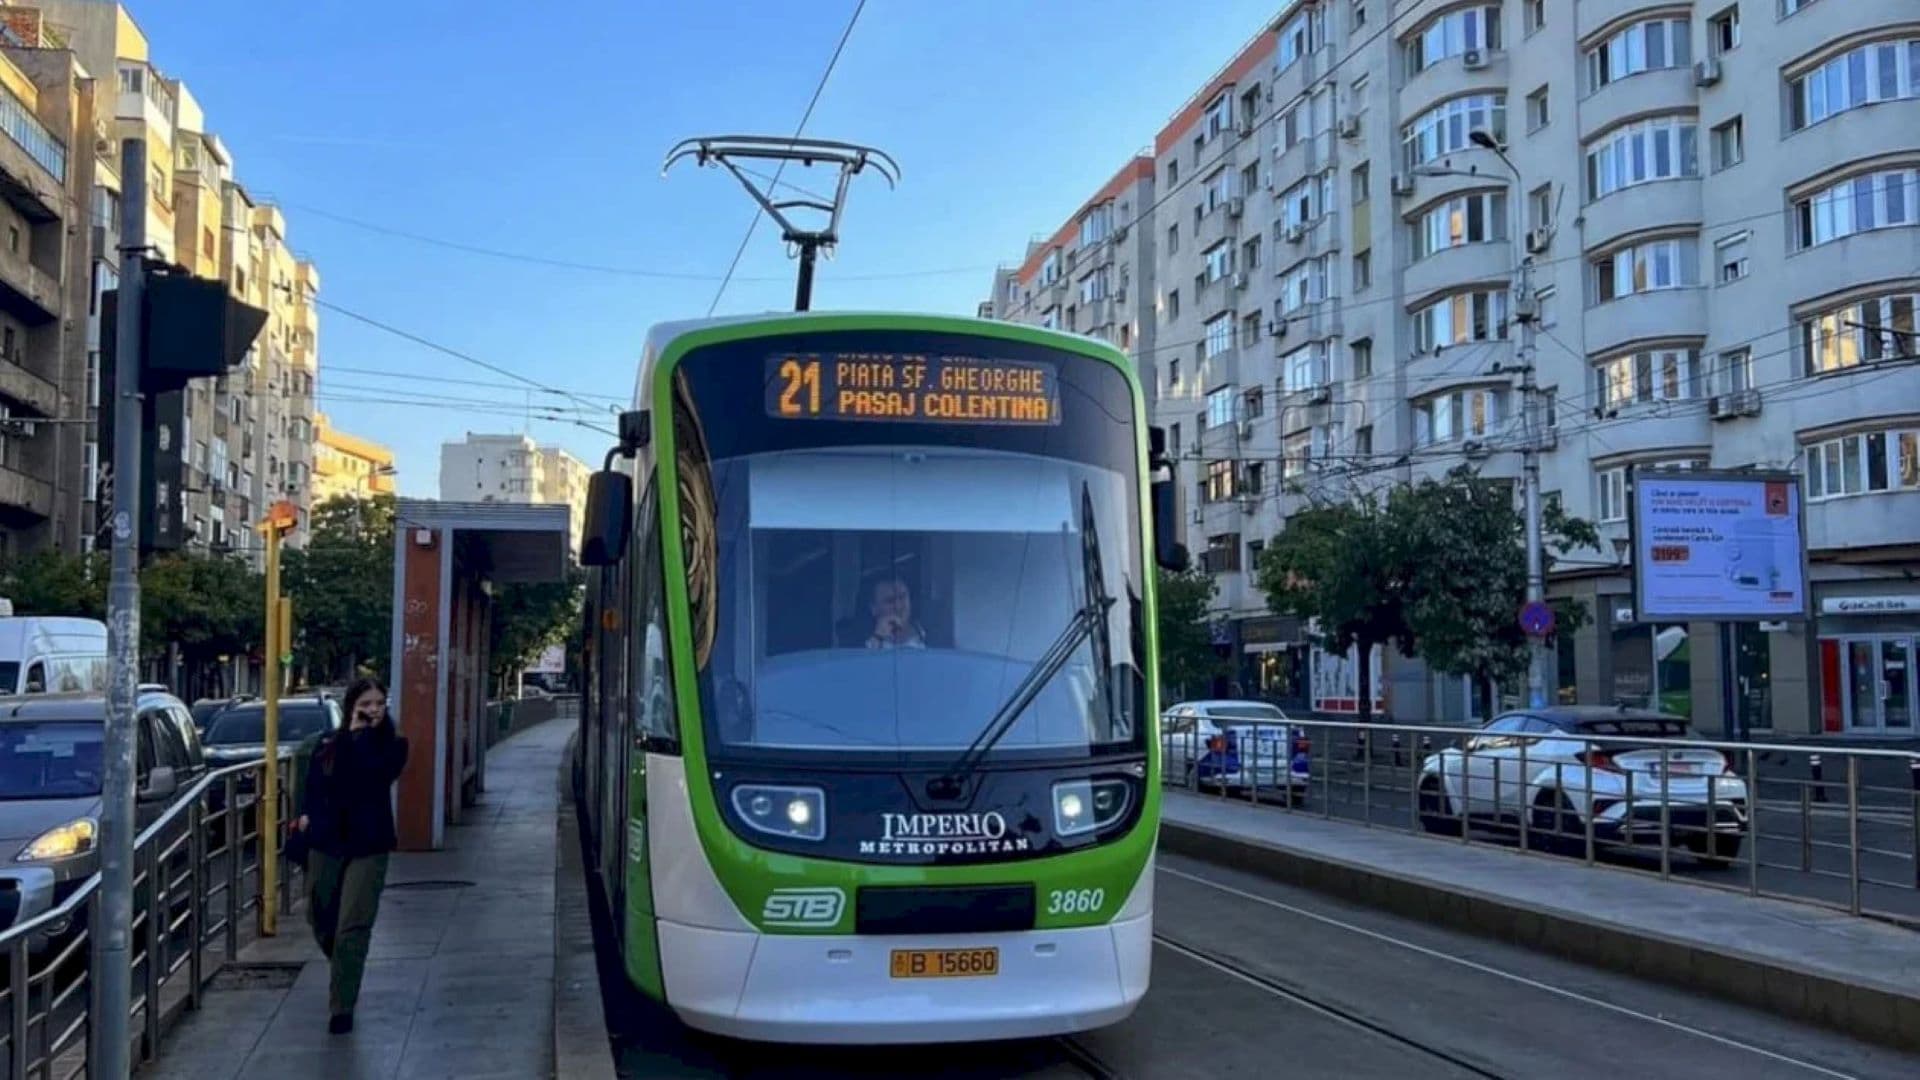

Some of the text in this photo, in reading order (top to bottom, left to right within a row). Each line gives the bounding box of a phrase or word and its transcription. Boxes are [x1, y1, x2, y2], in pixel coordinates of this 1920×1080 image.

[779, 359, 821, 414] 21
[837, 362, 894, 388] PIATA
[941, 366, 1044, 393] GHEORGHE
[839, 390, 1049, 420] PASAJ COLENTINA
[881, 811, 1006, 841] IMPERIO
[860, 838, 1029, 854] METROPOLITAN
[763, 894, 839, 919] STB
[1048, 887, 1105, 915] 3860
[910, 950, 996, 974] B 15660
